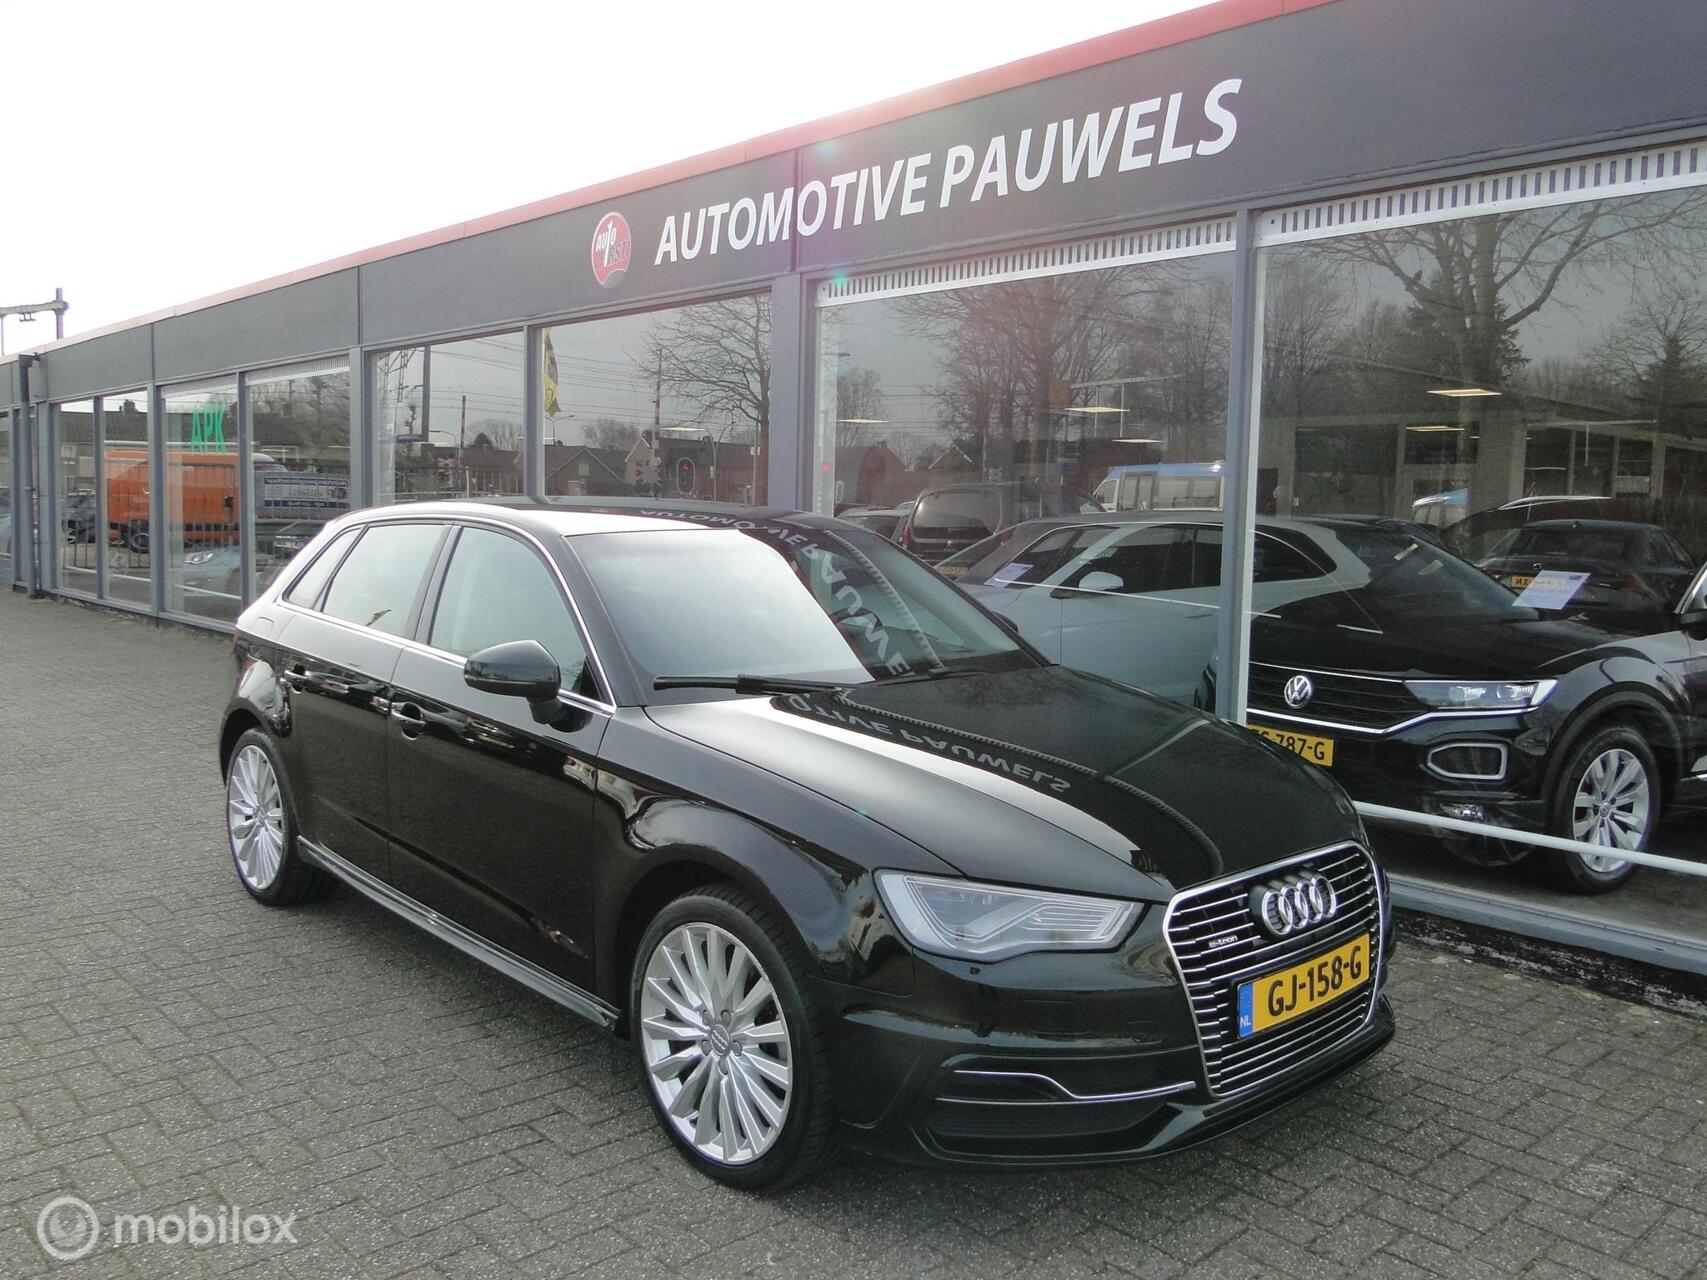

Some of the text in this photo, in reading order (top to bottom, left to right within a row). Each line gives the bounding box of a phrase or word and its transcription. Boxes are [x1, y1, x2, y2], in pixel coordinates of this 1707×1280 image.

[654, 78, 1243, 265] AUTOMOTIVE PAUWELS
[191, 401, 228, 455] APK
[1268, 945, 1361, 1017] GJ-158-G
[1240, 1015, 1251, 1028] NL
